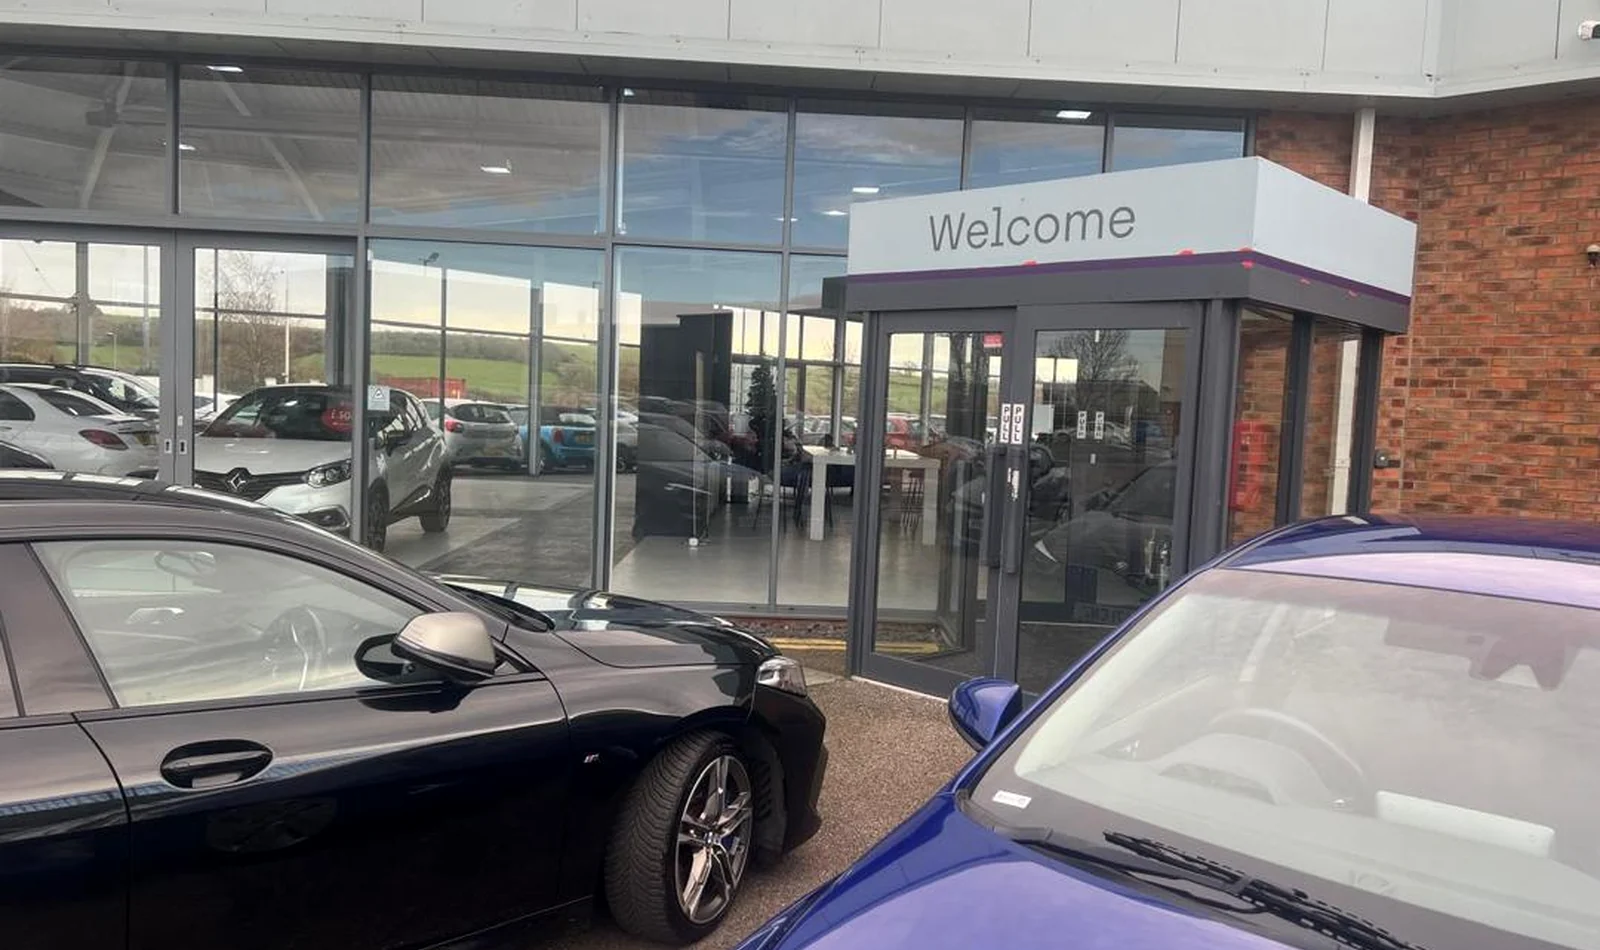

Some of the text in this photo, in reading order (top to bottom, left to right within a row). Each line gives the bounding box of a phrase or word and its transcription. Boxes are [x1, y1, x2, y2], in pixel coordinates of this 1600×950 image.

[929, 206, 1136, 251] Welcome
[1001, 405, 1010, 441] PULL
[1013, 405, 1023, 442] PULL
